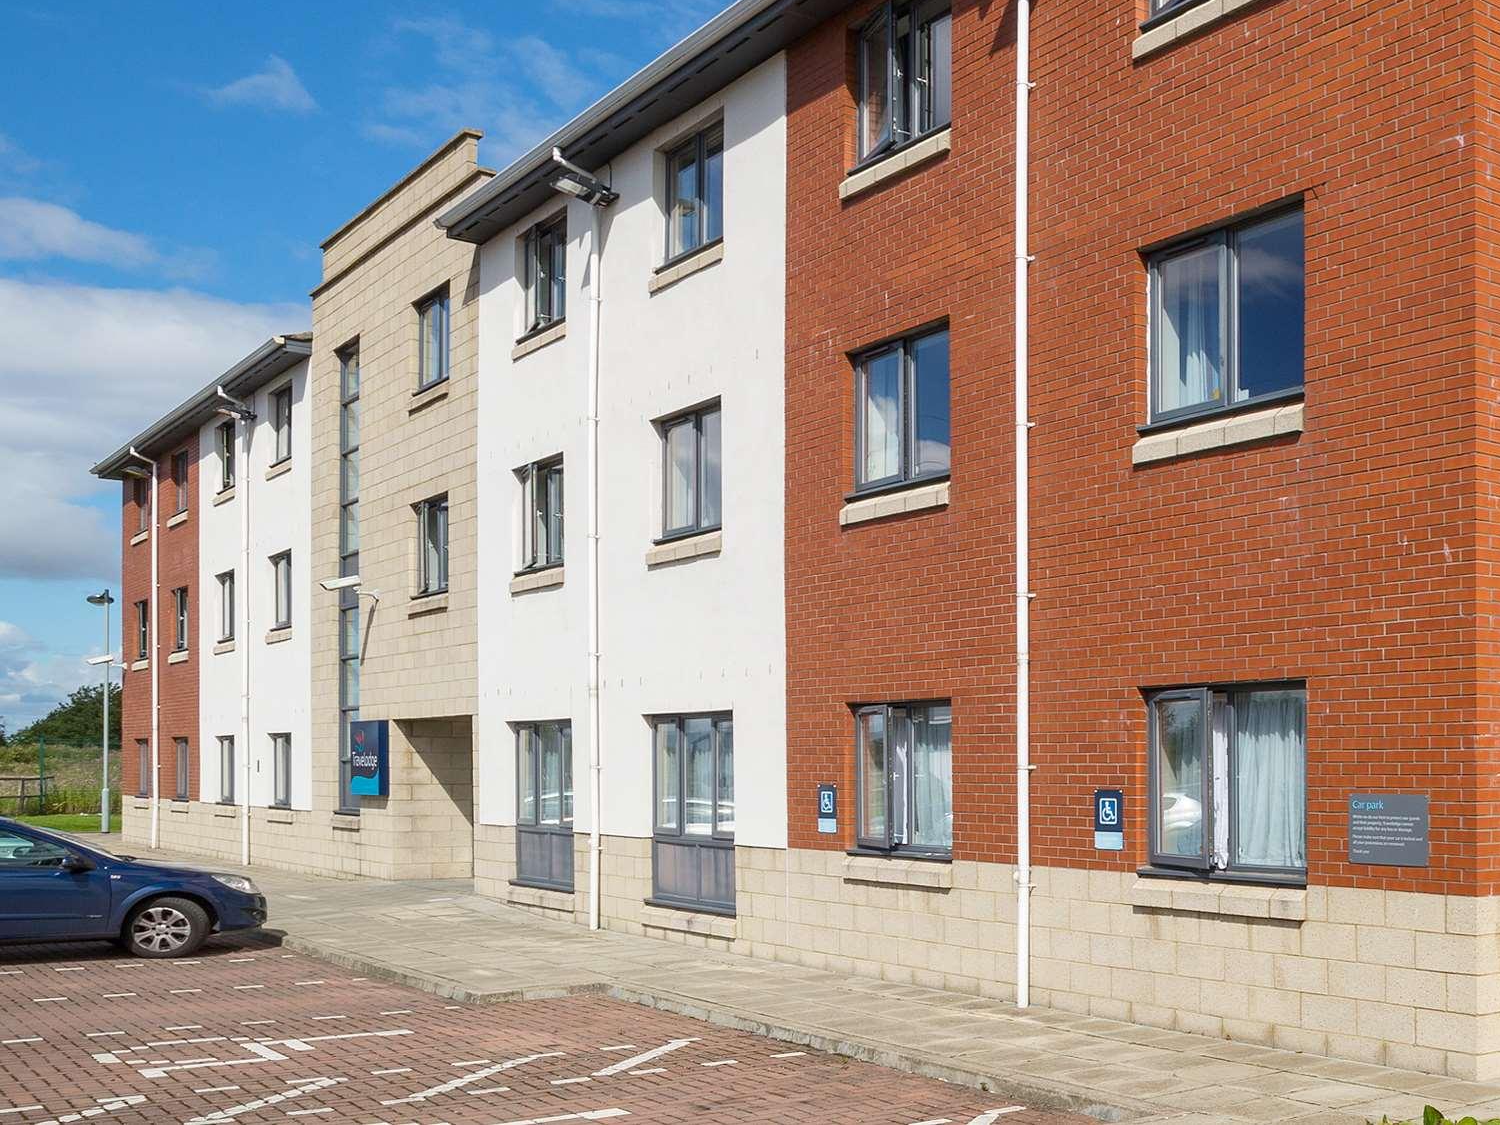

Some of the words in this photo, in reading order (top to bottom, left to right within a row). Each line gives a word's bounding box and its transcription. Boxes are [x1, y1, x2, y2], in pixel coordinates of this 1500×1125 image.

[352, 751, 377, 770] Travelodge
[1352, 800, 1365, 809] Car
[1366, 800, 1384, 811] park
